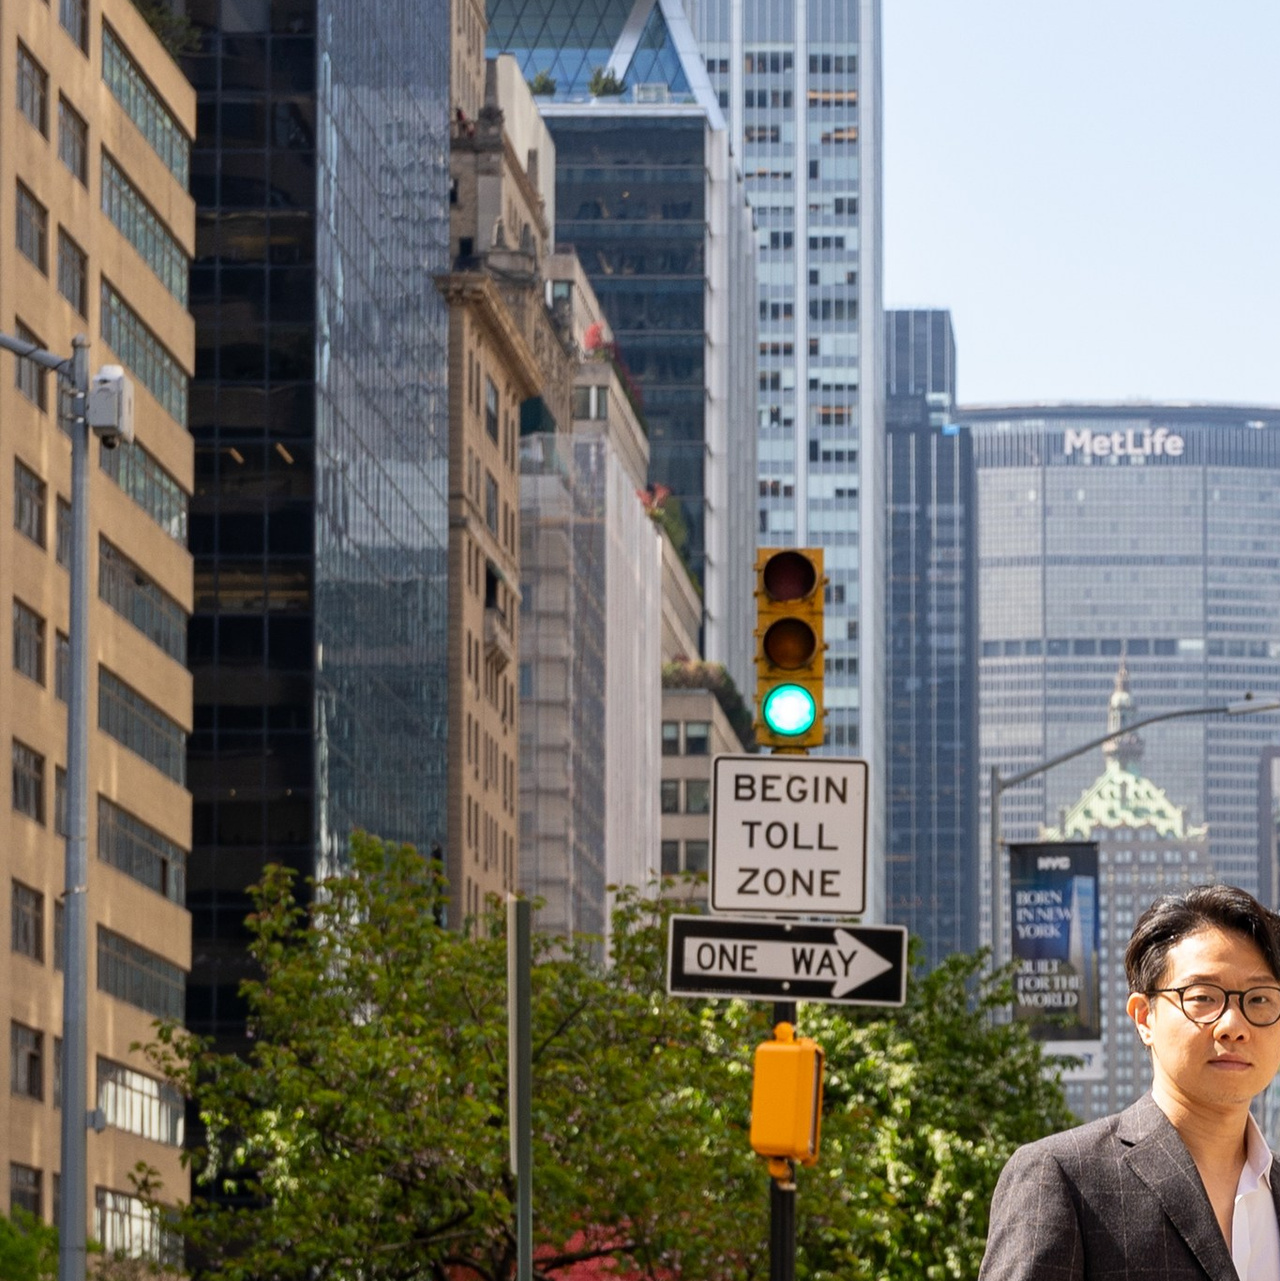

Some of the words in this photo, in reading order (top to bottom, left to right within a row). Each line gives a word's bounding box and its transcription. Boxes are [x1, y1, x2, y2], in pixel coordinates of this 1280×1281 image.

[1064, 427, 1185, 456] MetLife
[734, 774, 847, 804] BEGIN
[742, 821, 839, 850] TOLL
[737, 868, 841, 897] ZONE
[1016, 890, 1063, 906] BORN
[1016, 907, 1034, 922] IN
[1036, 907, 1072, 922] NEW
[1016, 924, 1062, 938] YORK
[697, 942, 757, 973] ONE
[792, 947, 858, 977] WAY
[1018, 975, 1051, 990] FOR
[1053, 975, 1084, 990] THE
[1018, 992, 1079, 1007] WORLD
